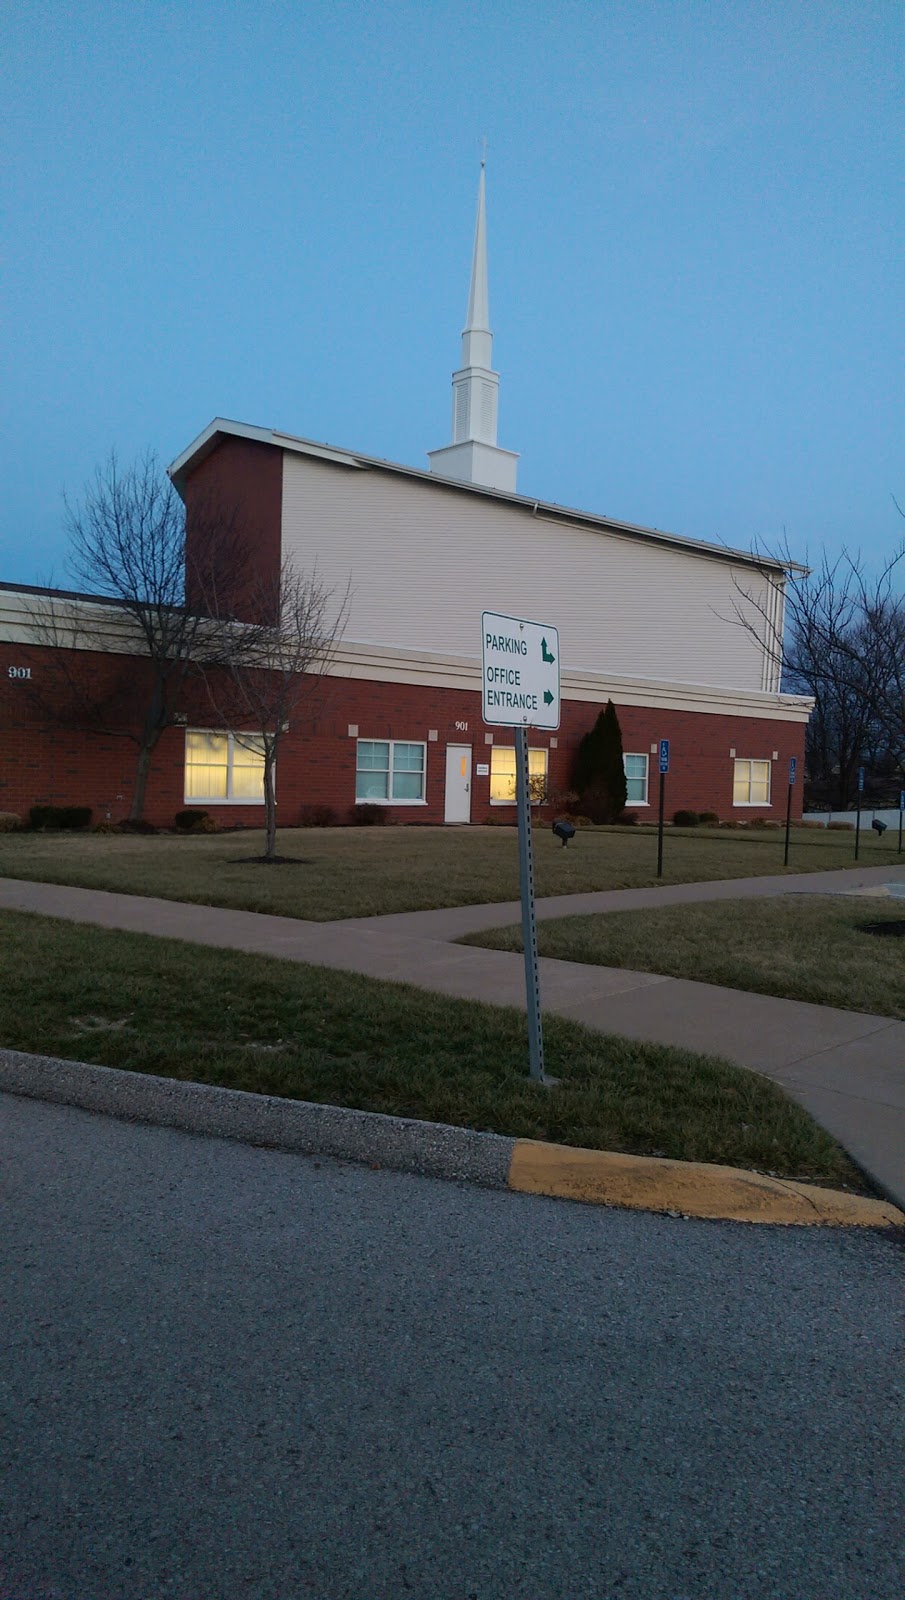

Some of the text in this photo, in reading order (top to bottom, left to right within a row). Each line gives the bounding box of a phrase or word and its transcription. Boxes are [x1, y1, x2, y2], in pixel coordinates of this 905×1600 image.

[486, 634, 527, 655] PARKING
[8, 666, 32, 679] 901
[487, 666, 520, 686] OFFICE
[487, 690, 538, 710] ENTRANCE
[455, 721, 468, 731] 901
